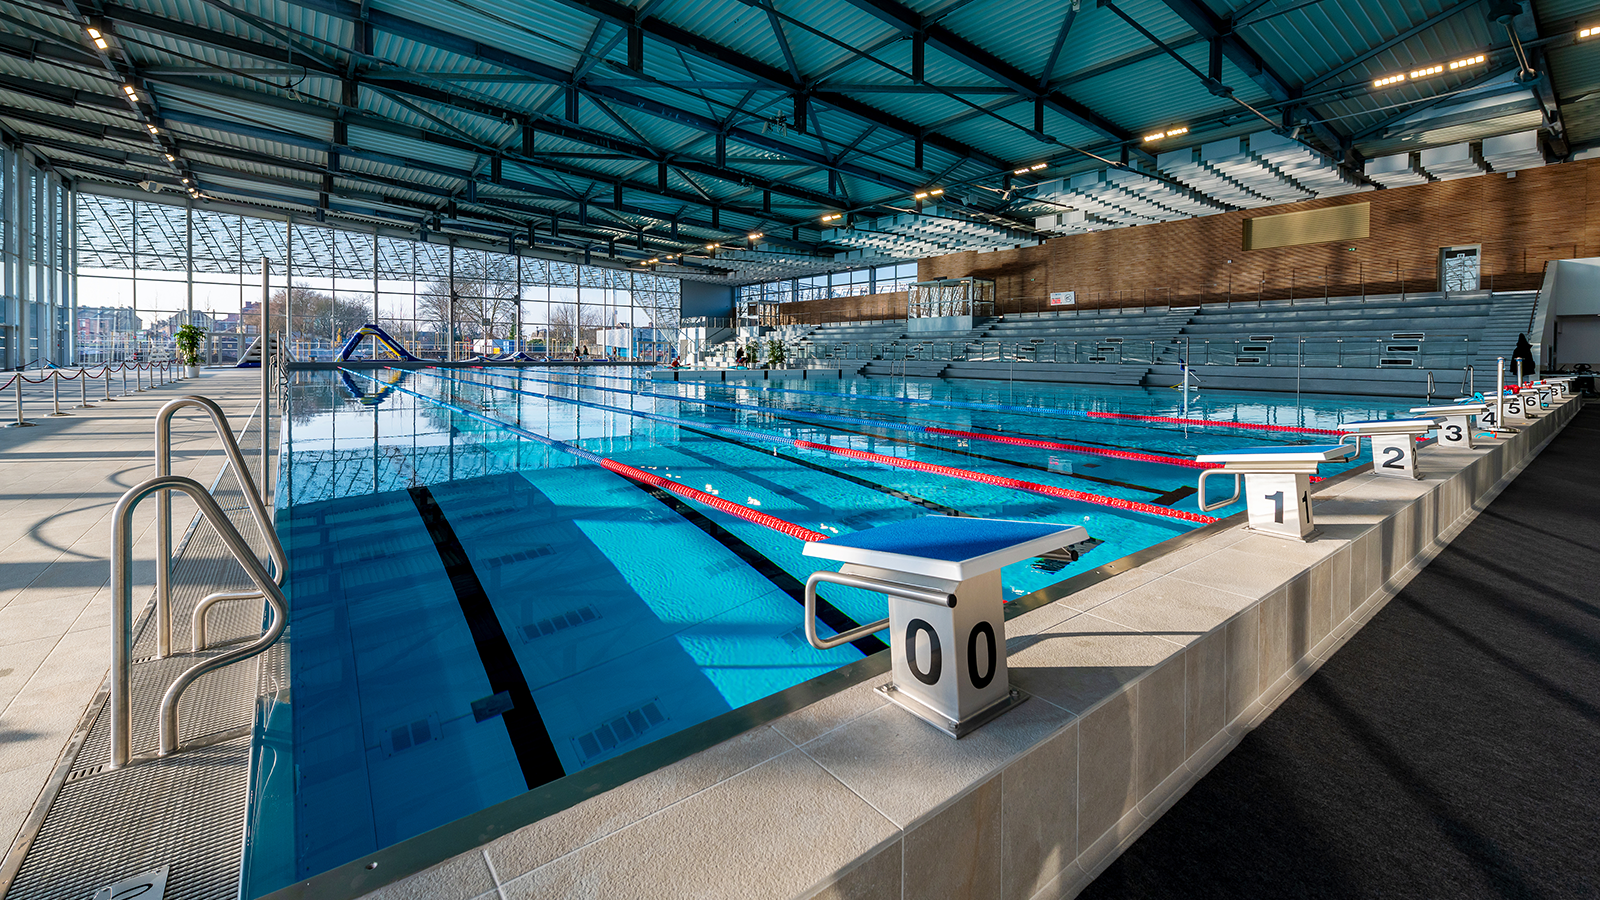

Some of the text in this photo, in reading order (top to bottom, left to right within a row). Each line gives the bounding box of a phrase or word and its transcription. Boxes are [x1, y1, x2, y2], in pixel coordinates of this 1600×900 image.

[1526, 396, 1536, 406] 6
[1540, 391, 1549, 400] 7
[1508, 403, 1520, 414] 5
[1482, 412, 1497, 425] 4
[1445, 425, 1462, 441] 3
[1382, 446, 1405, 469] 2
[1265, 491, 1284, 524] 1
[1302, 490, 1310, 524] 1
[905, 618, 942, 686] 0
[967, 621, 997, 690] 0
